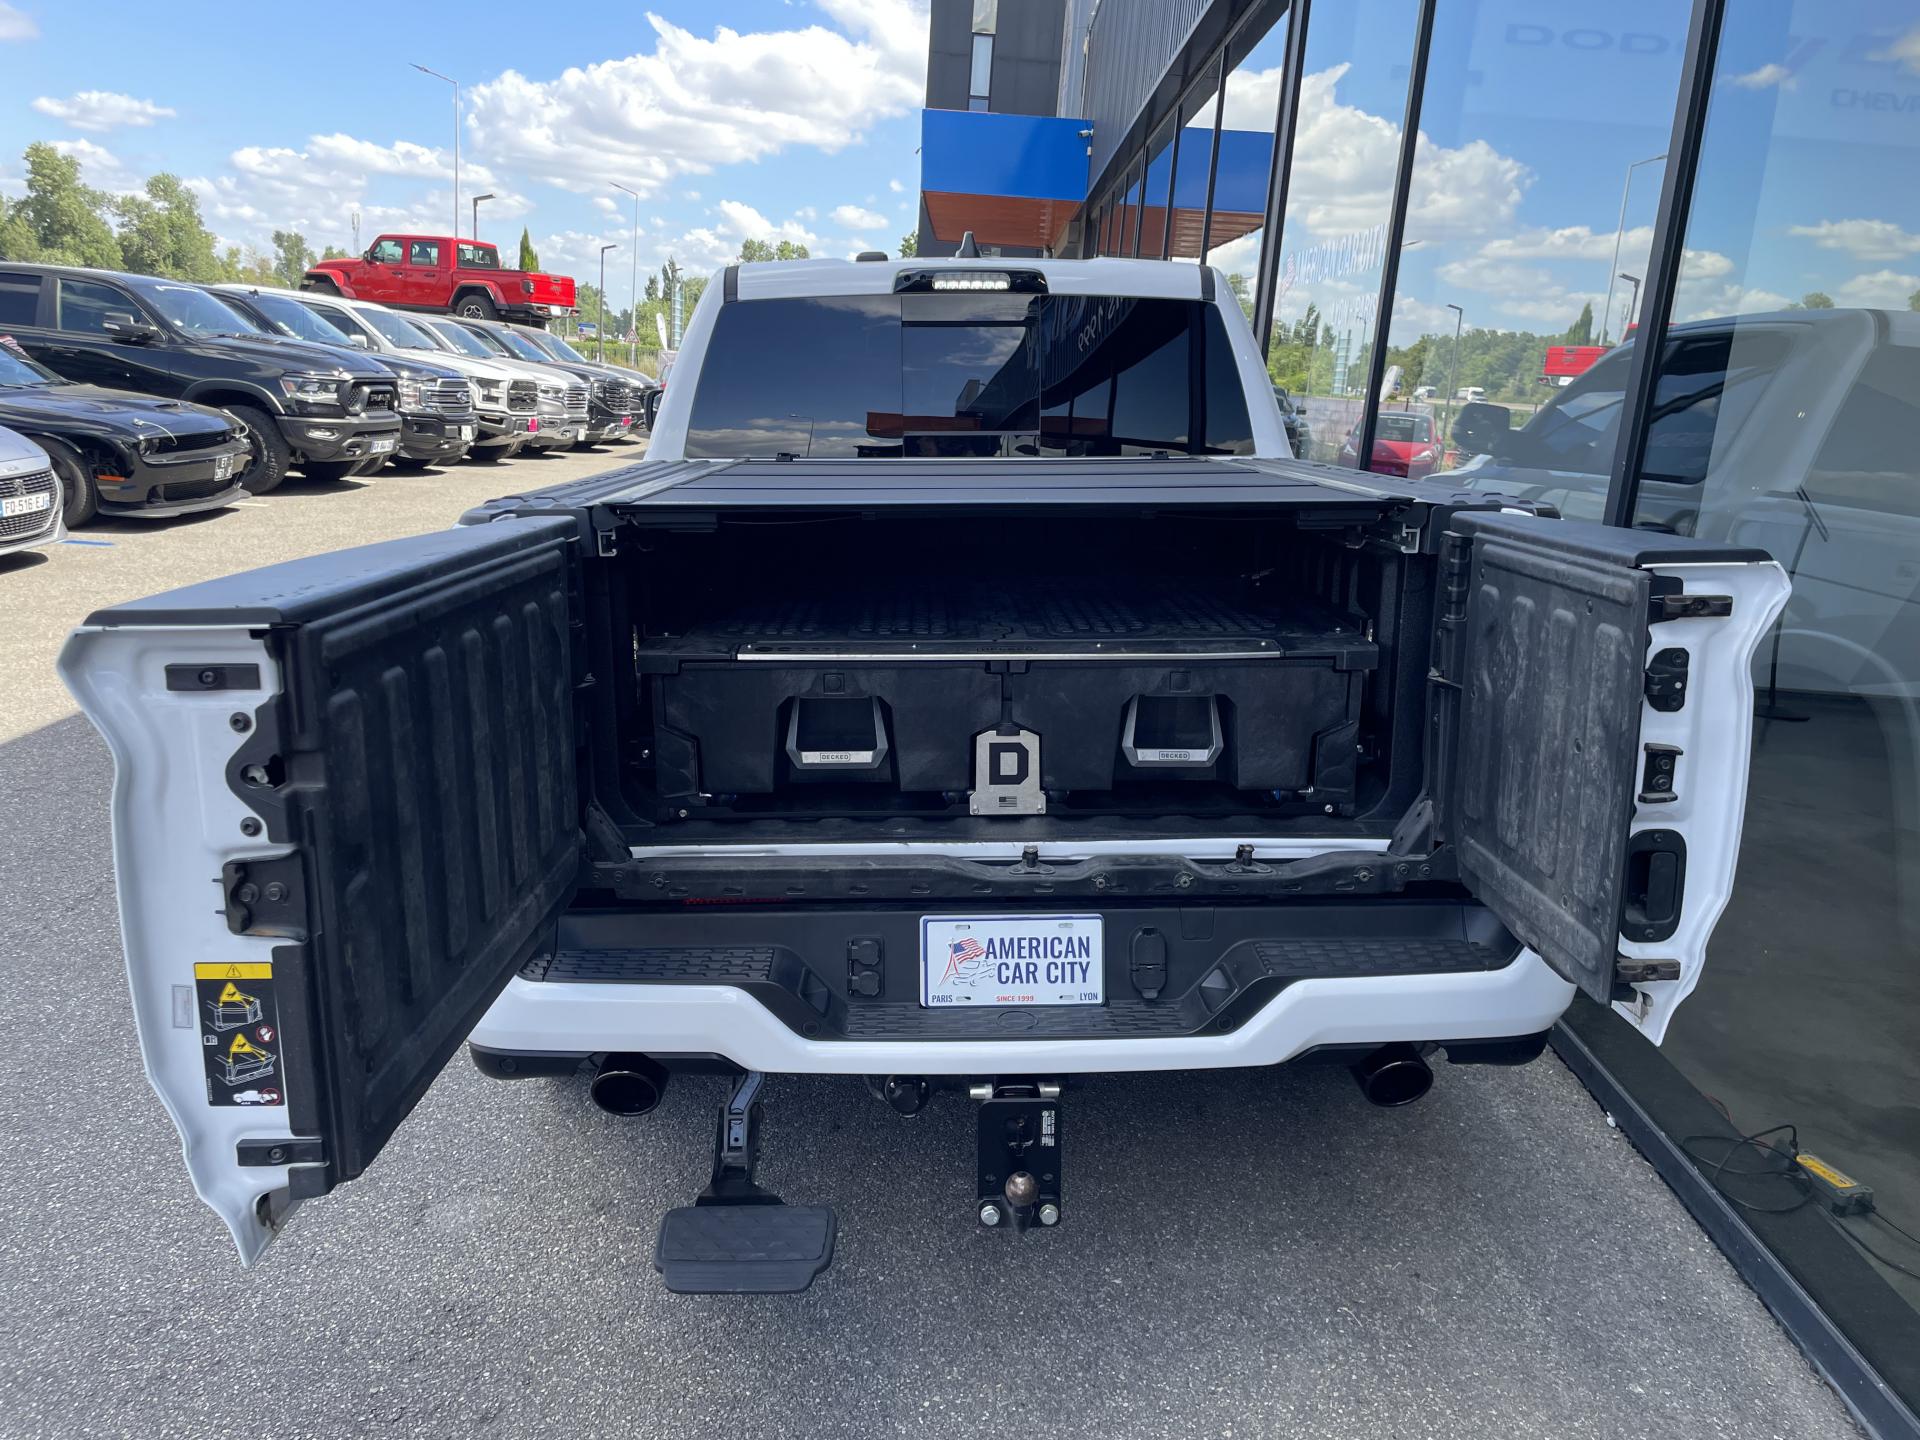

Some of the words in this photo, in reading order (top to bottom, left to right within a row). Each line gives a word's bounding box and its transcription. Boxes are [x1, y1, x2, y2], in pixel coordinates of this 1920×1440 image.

[1505, 24, 1685, 54] DOD
[989, 742, 1029, 786] D
[985, 935, 1091, 960] AMERICAN
[997, 961, 1039, 985] CAR
[1046, 961, 1091, 984] CITY
[931, 994, 953, 1003] PARIS
[1079, 992, 1098, 1001] LYON
